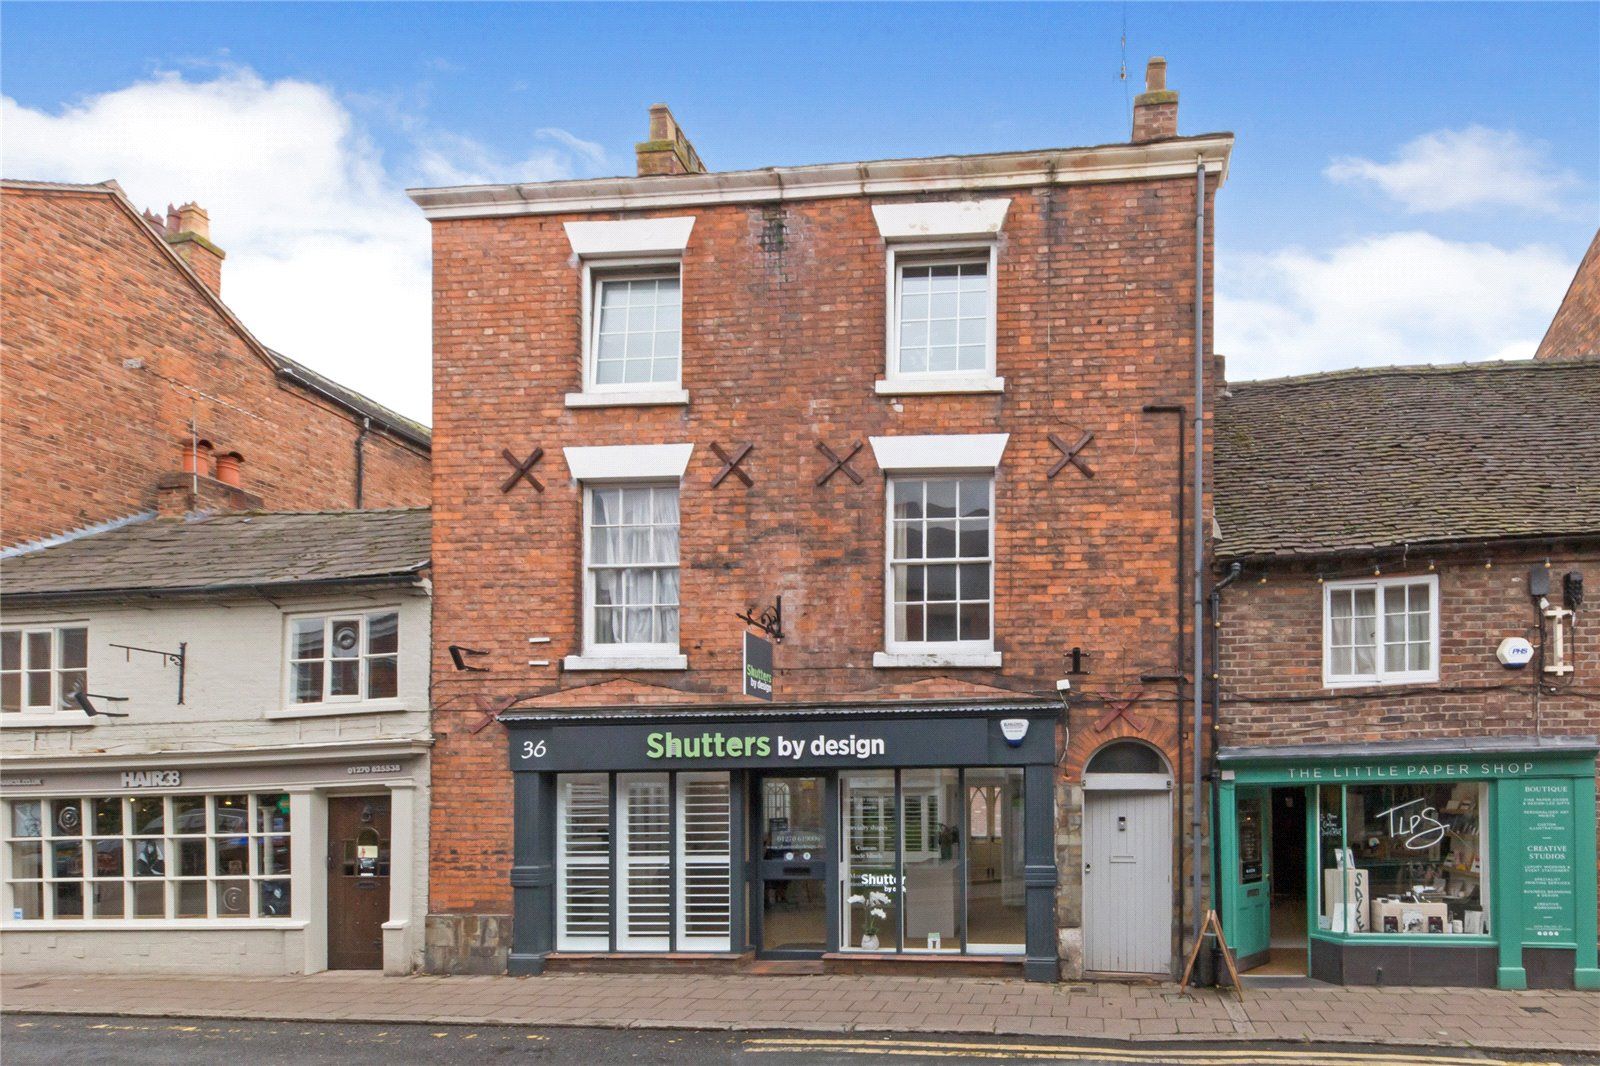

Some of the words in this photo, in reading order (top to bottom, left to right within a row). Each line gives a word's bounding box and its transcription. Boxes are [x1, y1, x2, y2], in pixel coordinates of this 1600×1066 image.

[746, 664, 772, 683] Shutters
[750, 677, 757, 689] by
[757, 680, 772, 693] design
[521, 740, 547, 759] 36
[646, 732, 771, 758] Shutters
[777, 736, 805, 759] by
[810, 735, 885, 758] design
[121, 770, 181, 787] HAIR38
[1288, 768, 1322, 778] THE
[1333, 766, 1398, 777] LITTLE
[1407, 764, 1470, 775] PAPER
[1481, 762, 1534, 774] SHOP
